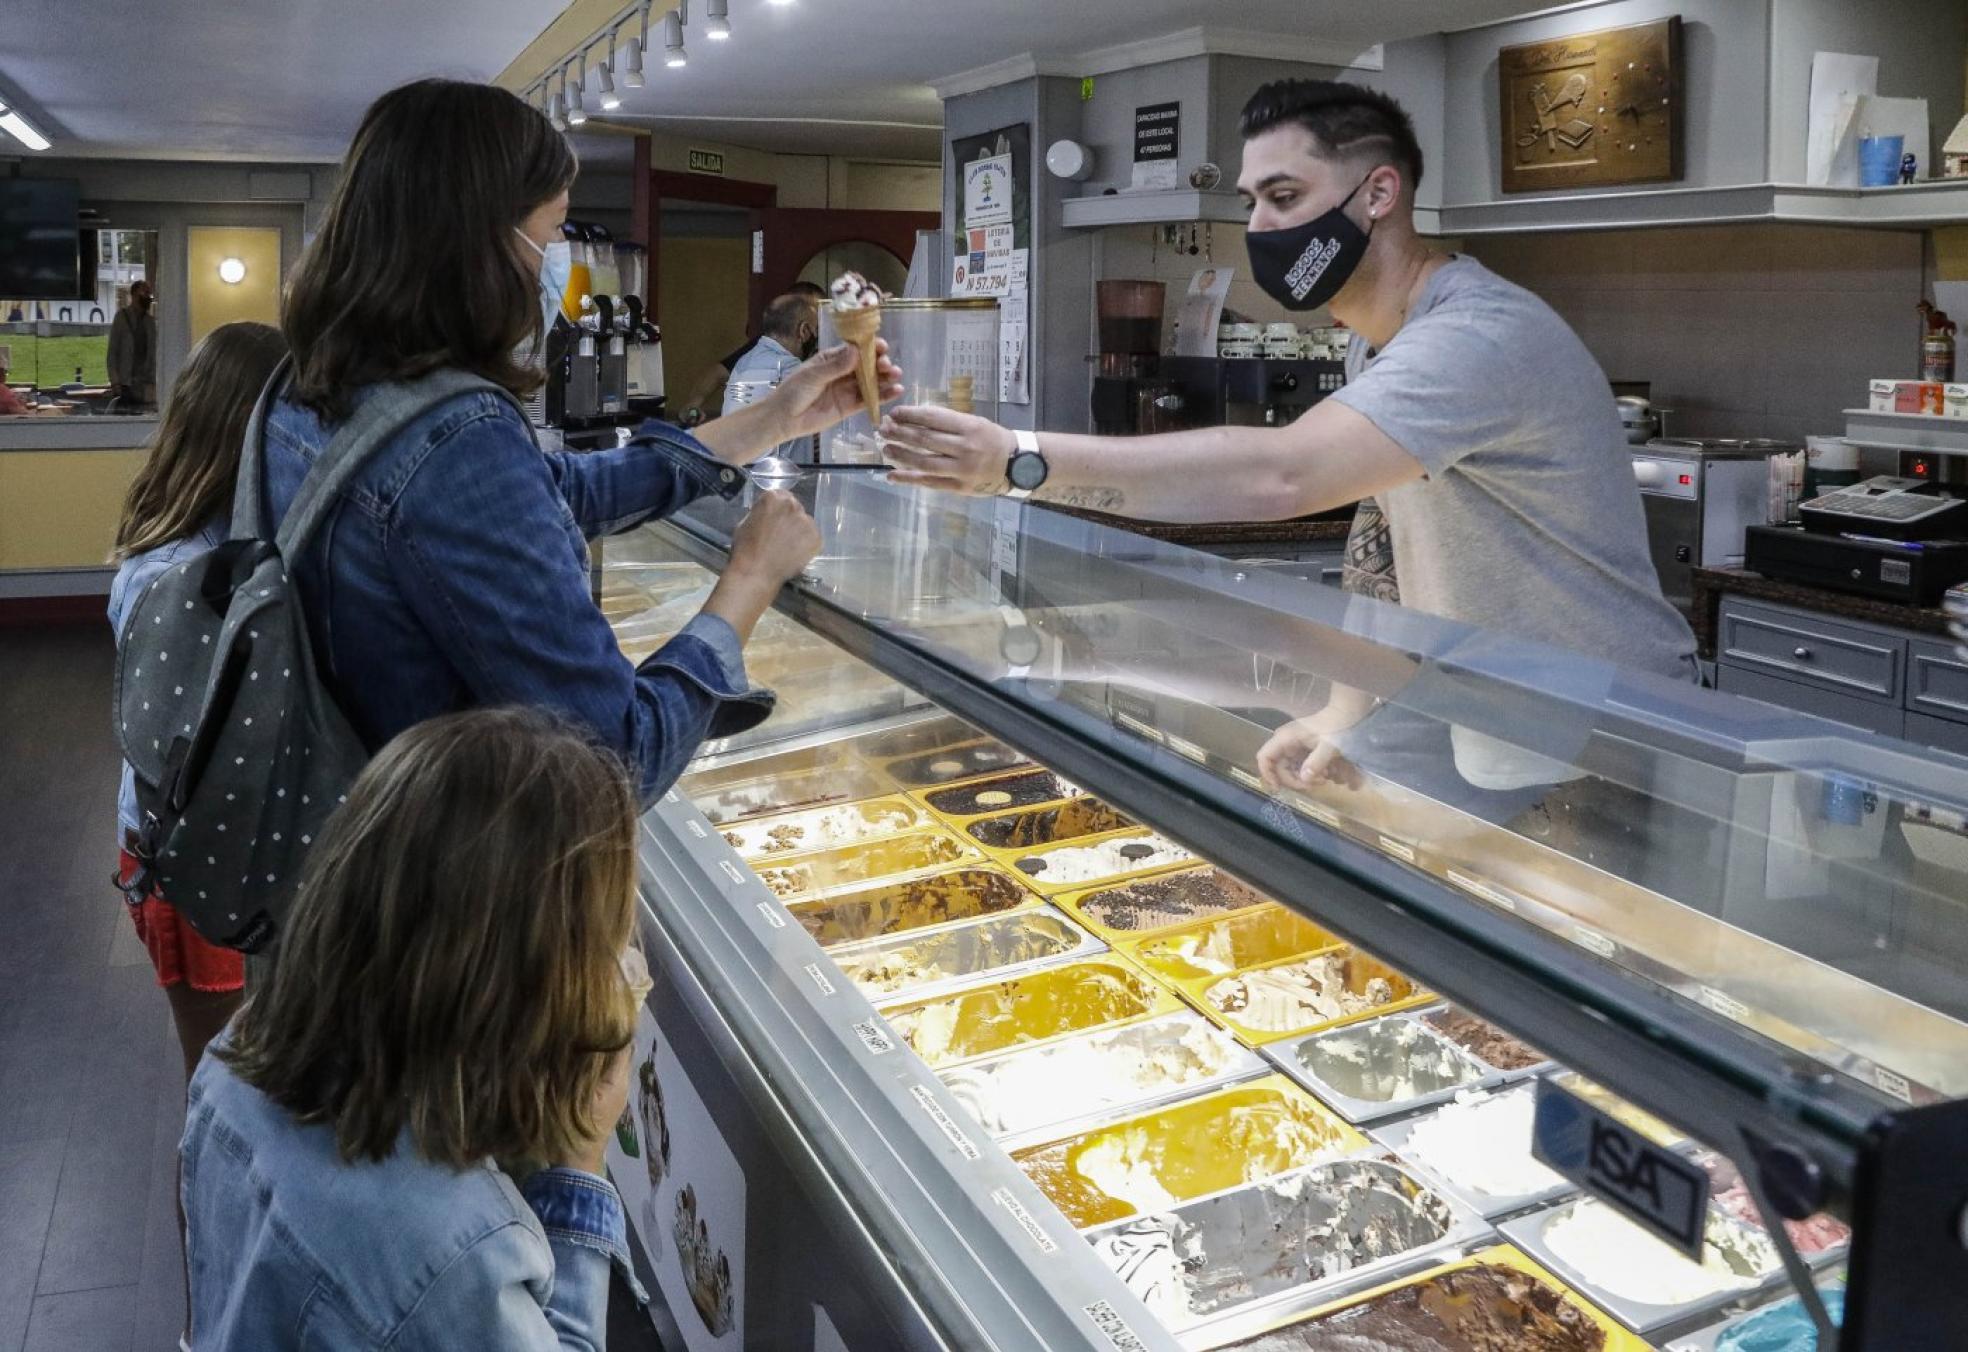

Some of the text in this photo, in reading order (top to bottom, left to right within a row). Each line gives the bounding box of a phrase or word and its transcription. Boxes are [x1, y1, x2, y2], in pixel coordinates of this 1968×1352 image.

[691, 152, 721, 172] SALIDA
[1290, 237, 1341, 301] HERMANOS
[975, 274, 1007, 291] 57.794
